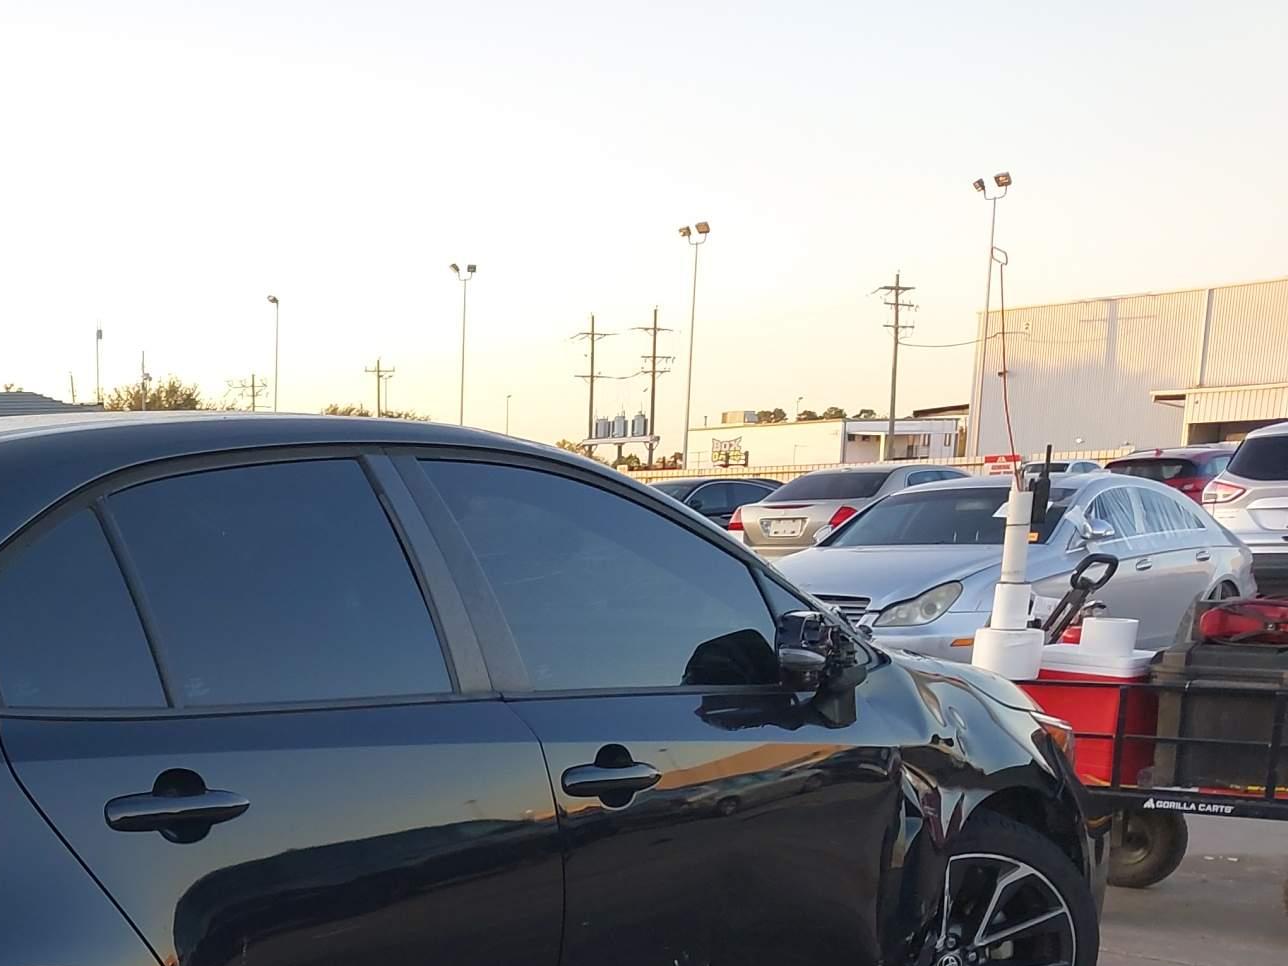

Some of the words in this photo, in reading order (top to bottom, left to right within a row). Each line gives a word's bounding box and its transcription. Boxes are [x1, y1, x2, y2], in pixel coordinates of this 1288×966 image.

[712, 436, 742, 452] BOX
[1155, 800, 1196, 811] GORILLA
[1198, 804, 1232, 814] CARTS
